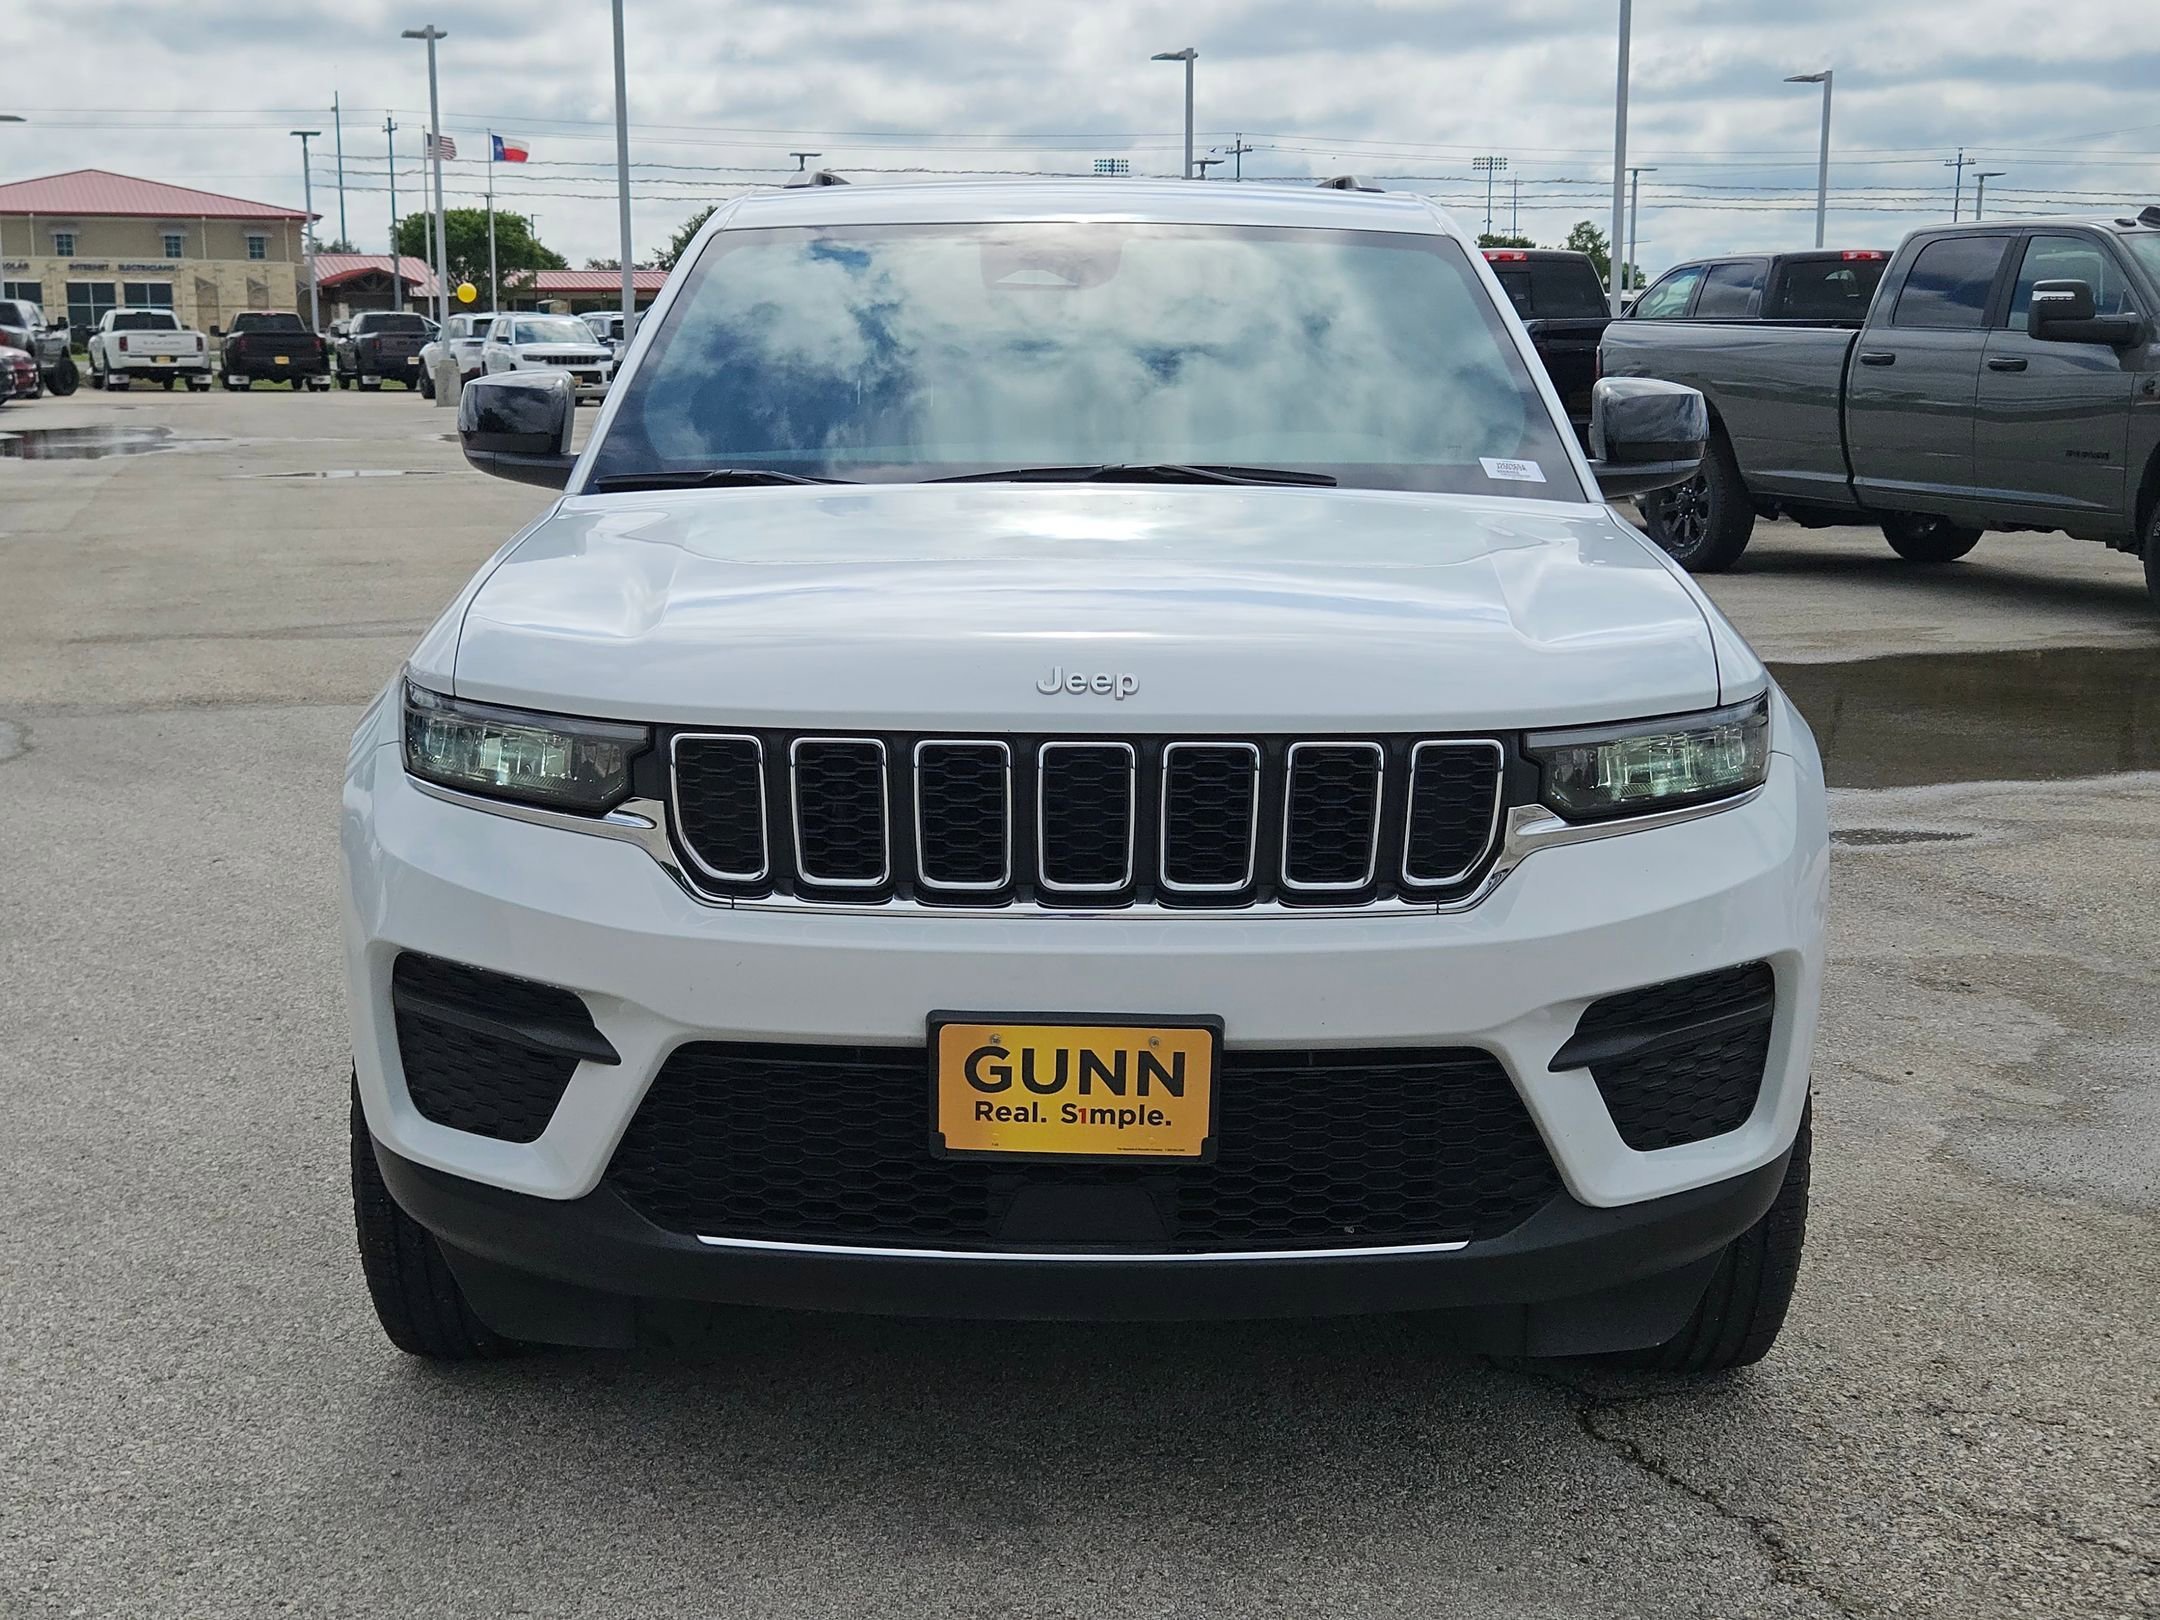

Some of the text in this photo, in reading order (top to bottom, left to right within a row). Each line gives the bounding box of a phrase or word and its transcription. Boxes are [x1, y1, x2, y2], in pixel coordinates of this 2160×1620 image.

[1036, 665, 1140, 700] Jeep
[964, 1046, 1186, 1098] GUNN
[975, 1101, 1048, 1123] Real.
